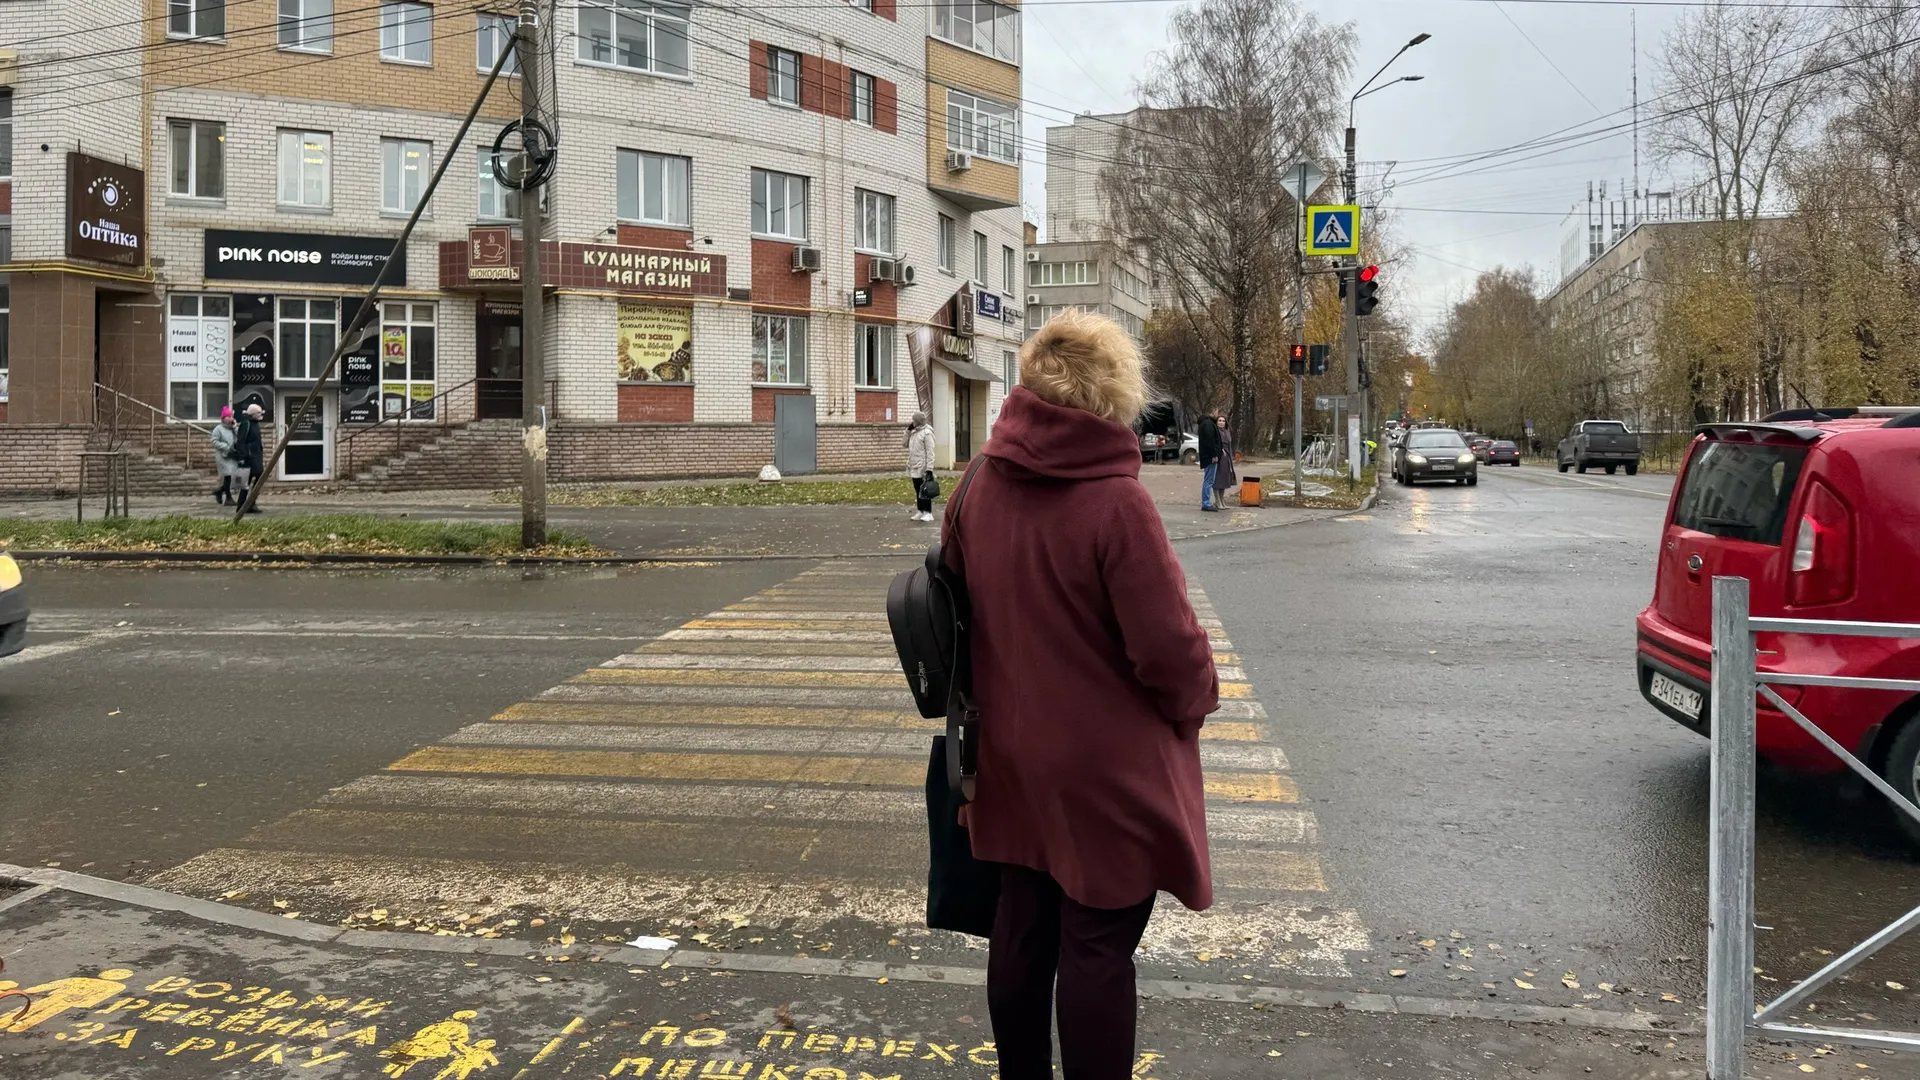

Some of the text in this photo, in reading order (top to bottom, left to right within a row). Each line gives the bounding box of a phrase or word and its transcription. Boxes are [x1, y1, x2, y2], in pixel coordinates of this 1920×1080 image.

[79, 220, 138, 248] Оптика
[99, 218, 120, 231] Наша
[331, 252, 354, 260] ВОЙДИ
[473, 239, 481, 260] КАФЕ
[337, 259, 373, 267] КОМФОРТА
[583, 250, 711, 274] КУЛИНАРНЫЙ
[606, 269, 692, 288] МАГАЗИН
[621, 305, 655, 314] Пироги,
[648, 333, 673, 341] заказ
[145, 976, 393, 1018] ВОЗЬМИ
[95, 998, 378, 1046] РЕБЁНКА
[54, 1021, 350, 1068] ЗА РУКУ
[639, 1025, 1000, 1066] ПО ПЕРЕХО
